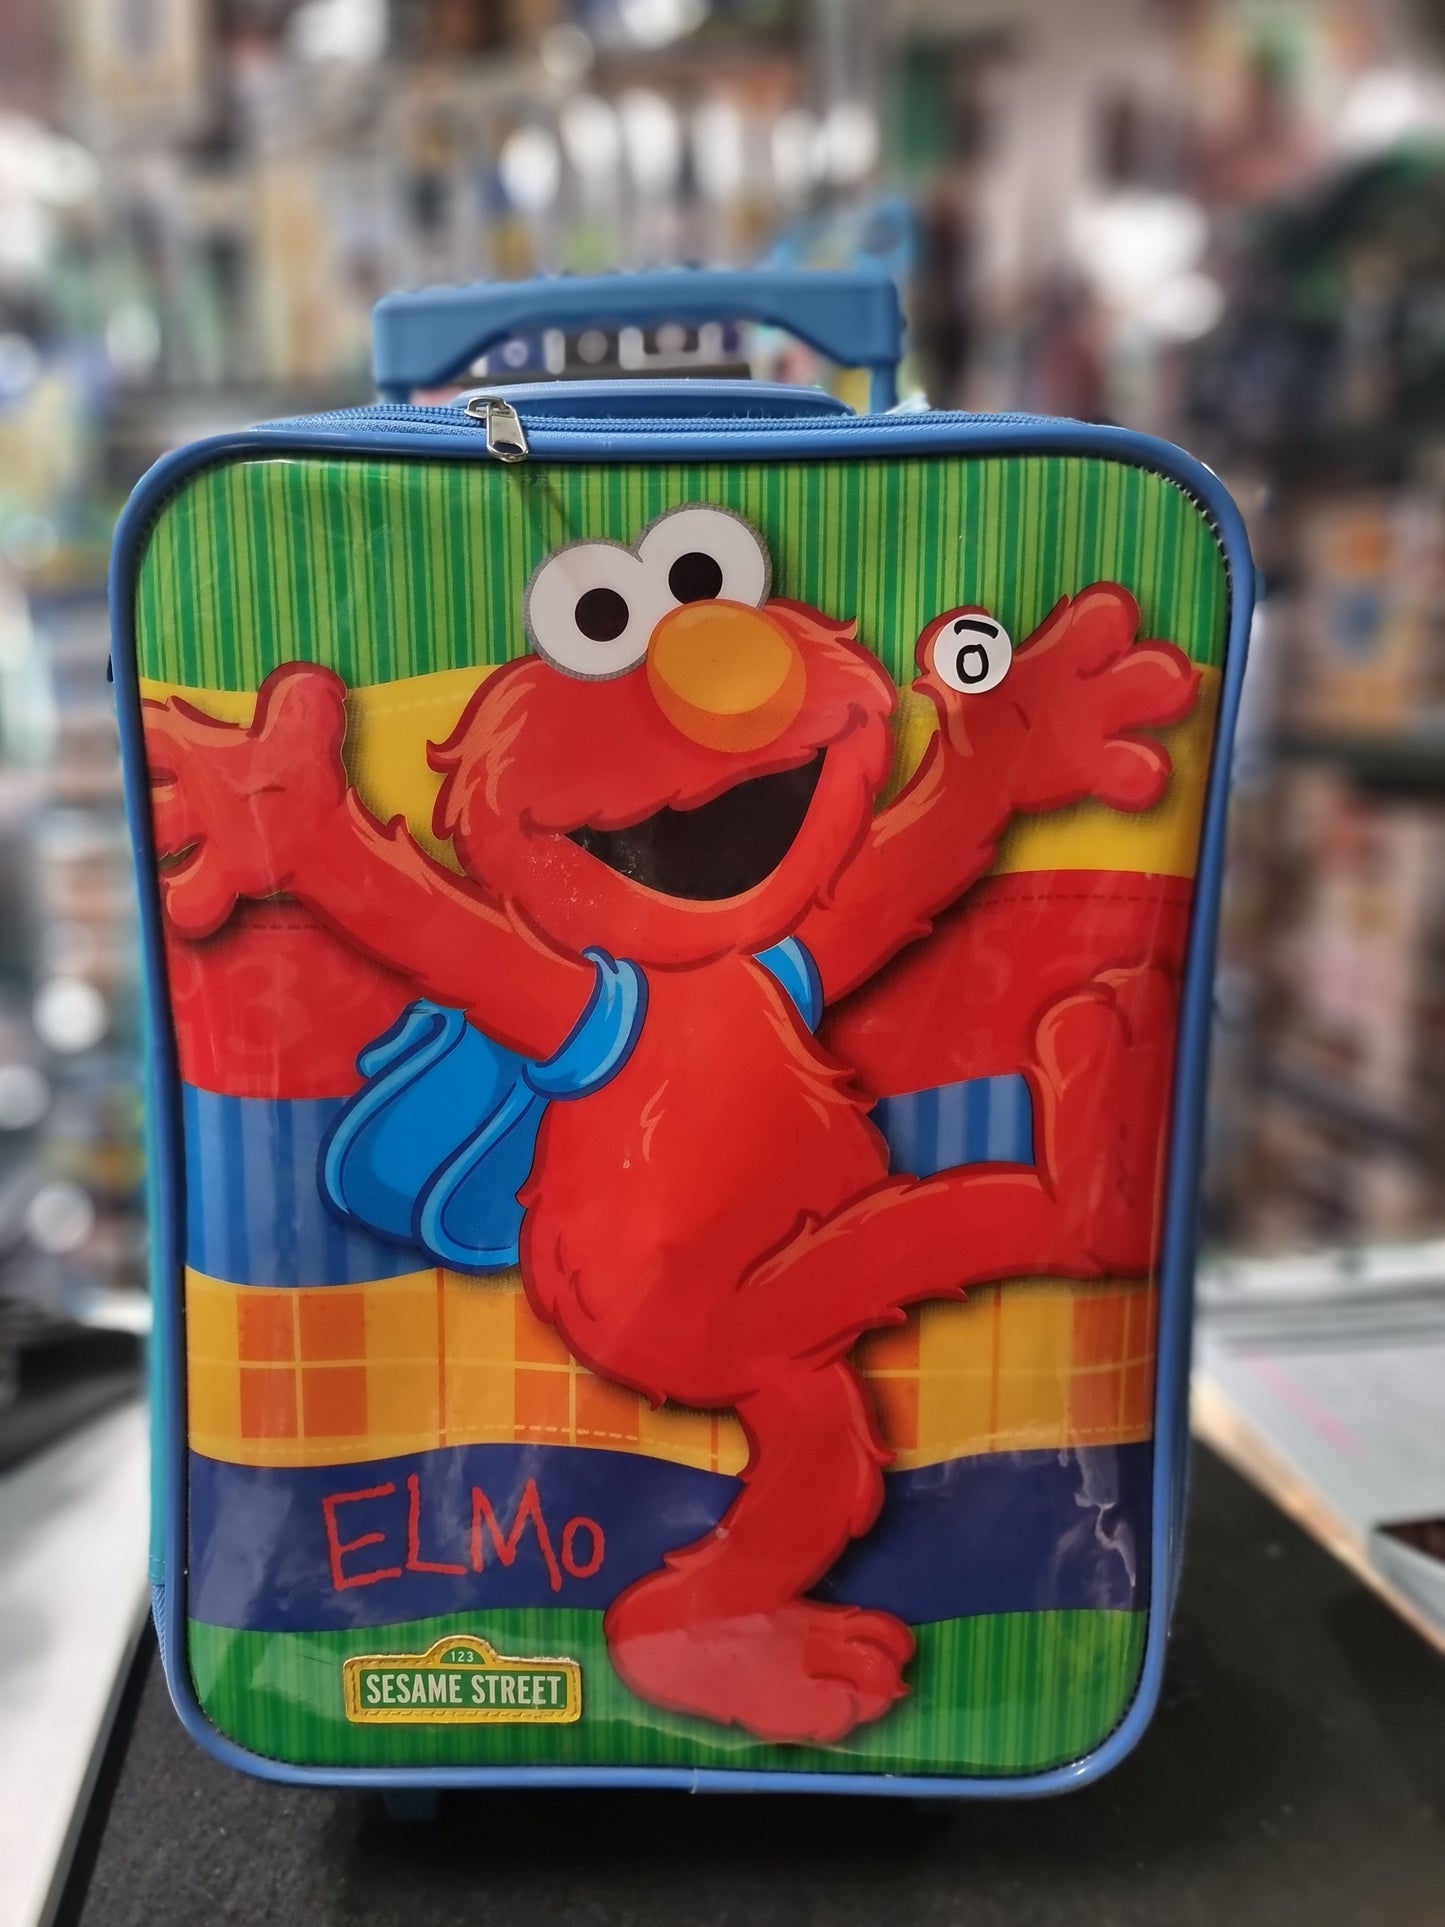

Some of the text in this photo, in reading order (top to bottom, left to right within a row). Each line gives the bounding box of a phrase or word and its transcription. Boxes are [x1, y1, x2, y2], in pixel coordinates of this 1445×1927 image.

[451, 1650, 474, 1663] 123
[366, 1673, 561, 1705] SESAME STREET
